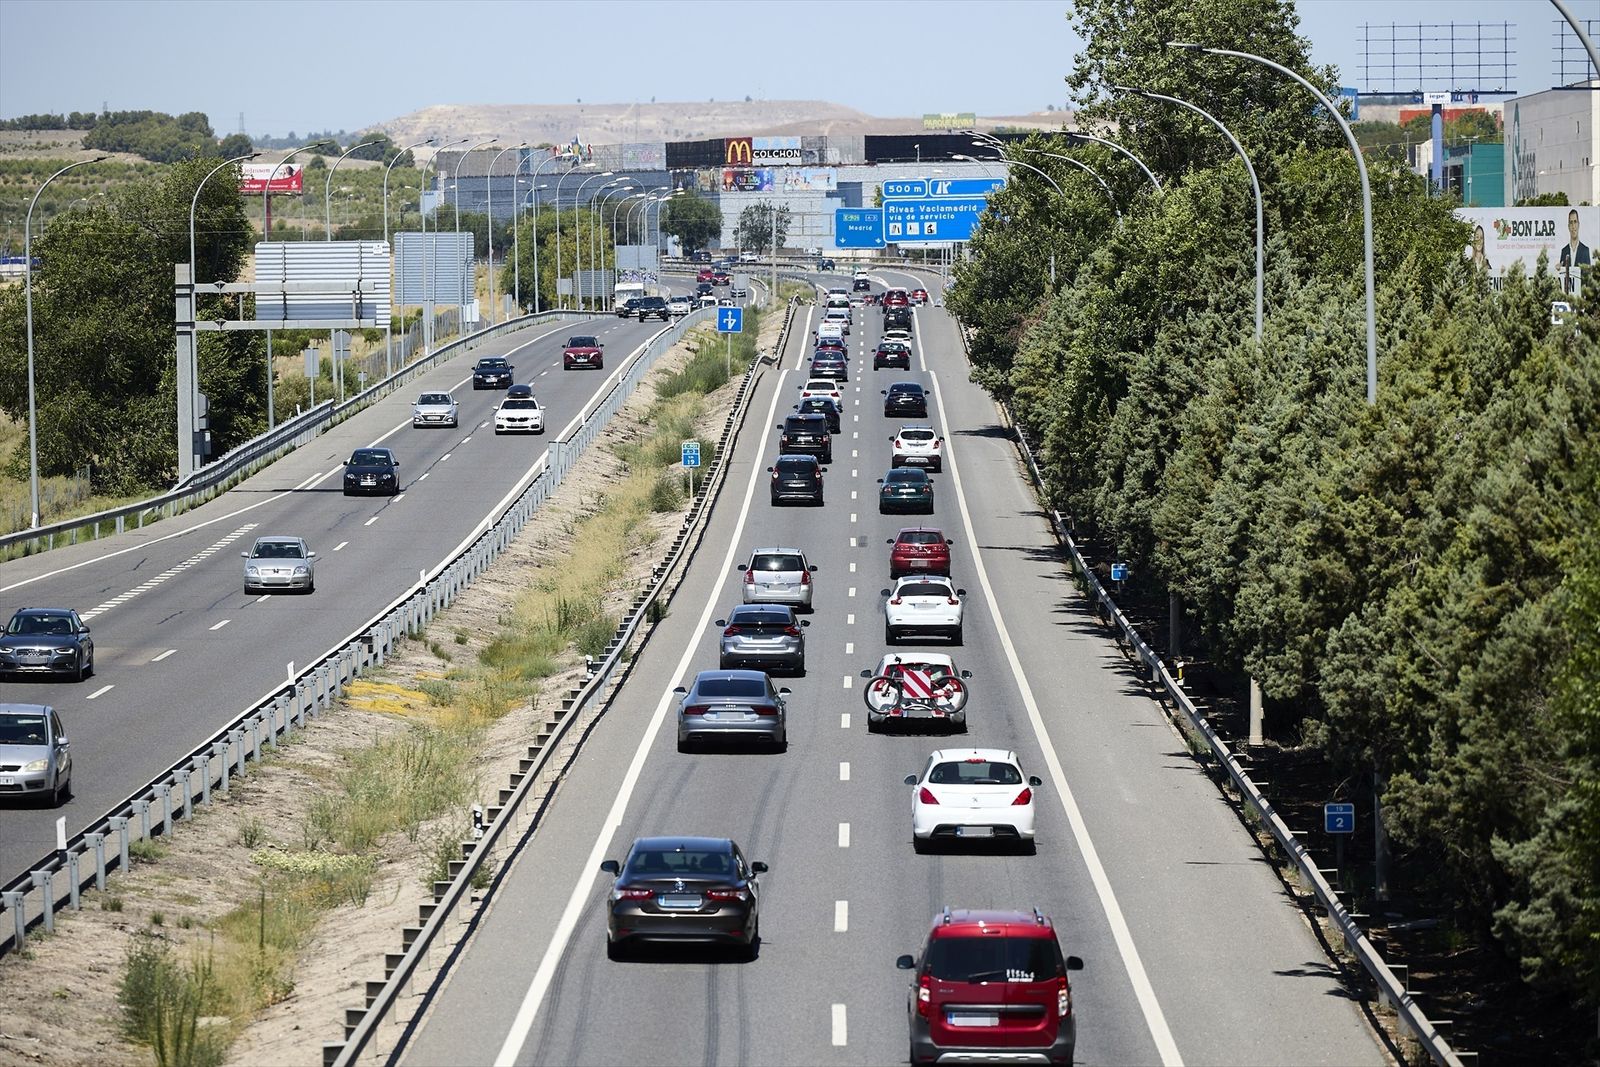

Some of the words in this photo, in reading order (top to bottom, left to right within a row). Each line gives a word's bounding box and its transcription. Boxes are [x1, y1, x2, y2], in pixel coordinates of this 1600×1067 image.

[752, 149, 801, 159] COLCHON
[888, 185, 911, 193] 500
[888, 205, 914, 213] Rivas
[919, 204, 977, 213] Vaciamadrid
[905, 213, 916, 221] de
[1511, 220, 1533, 237] BON
[1534, 220, 1556, 237] LAR
[1335, 817, 1345, 828] 2
